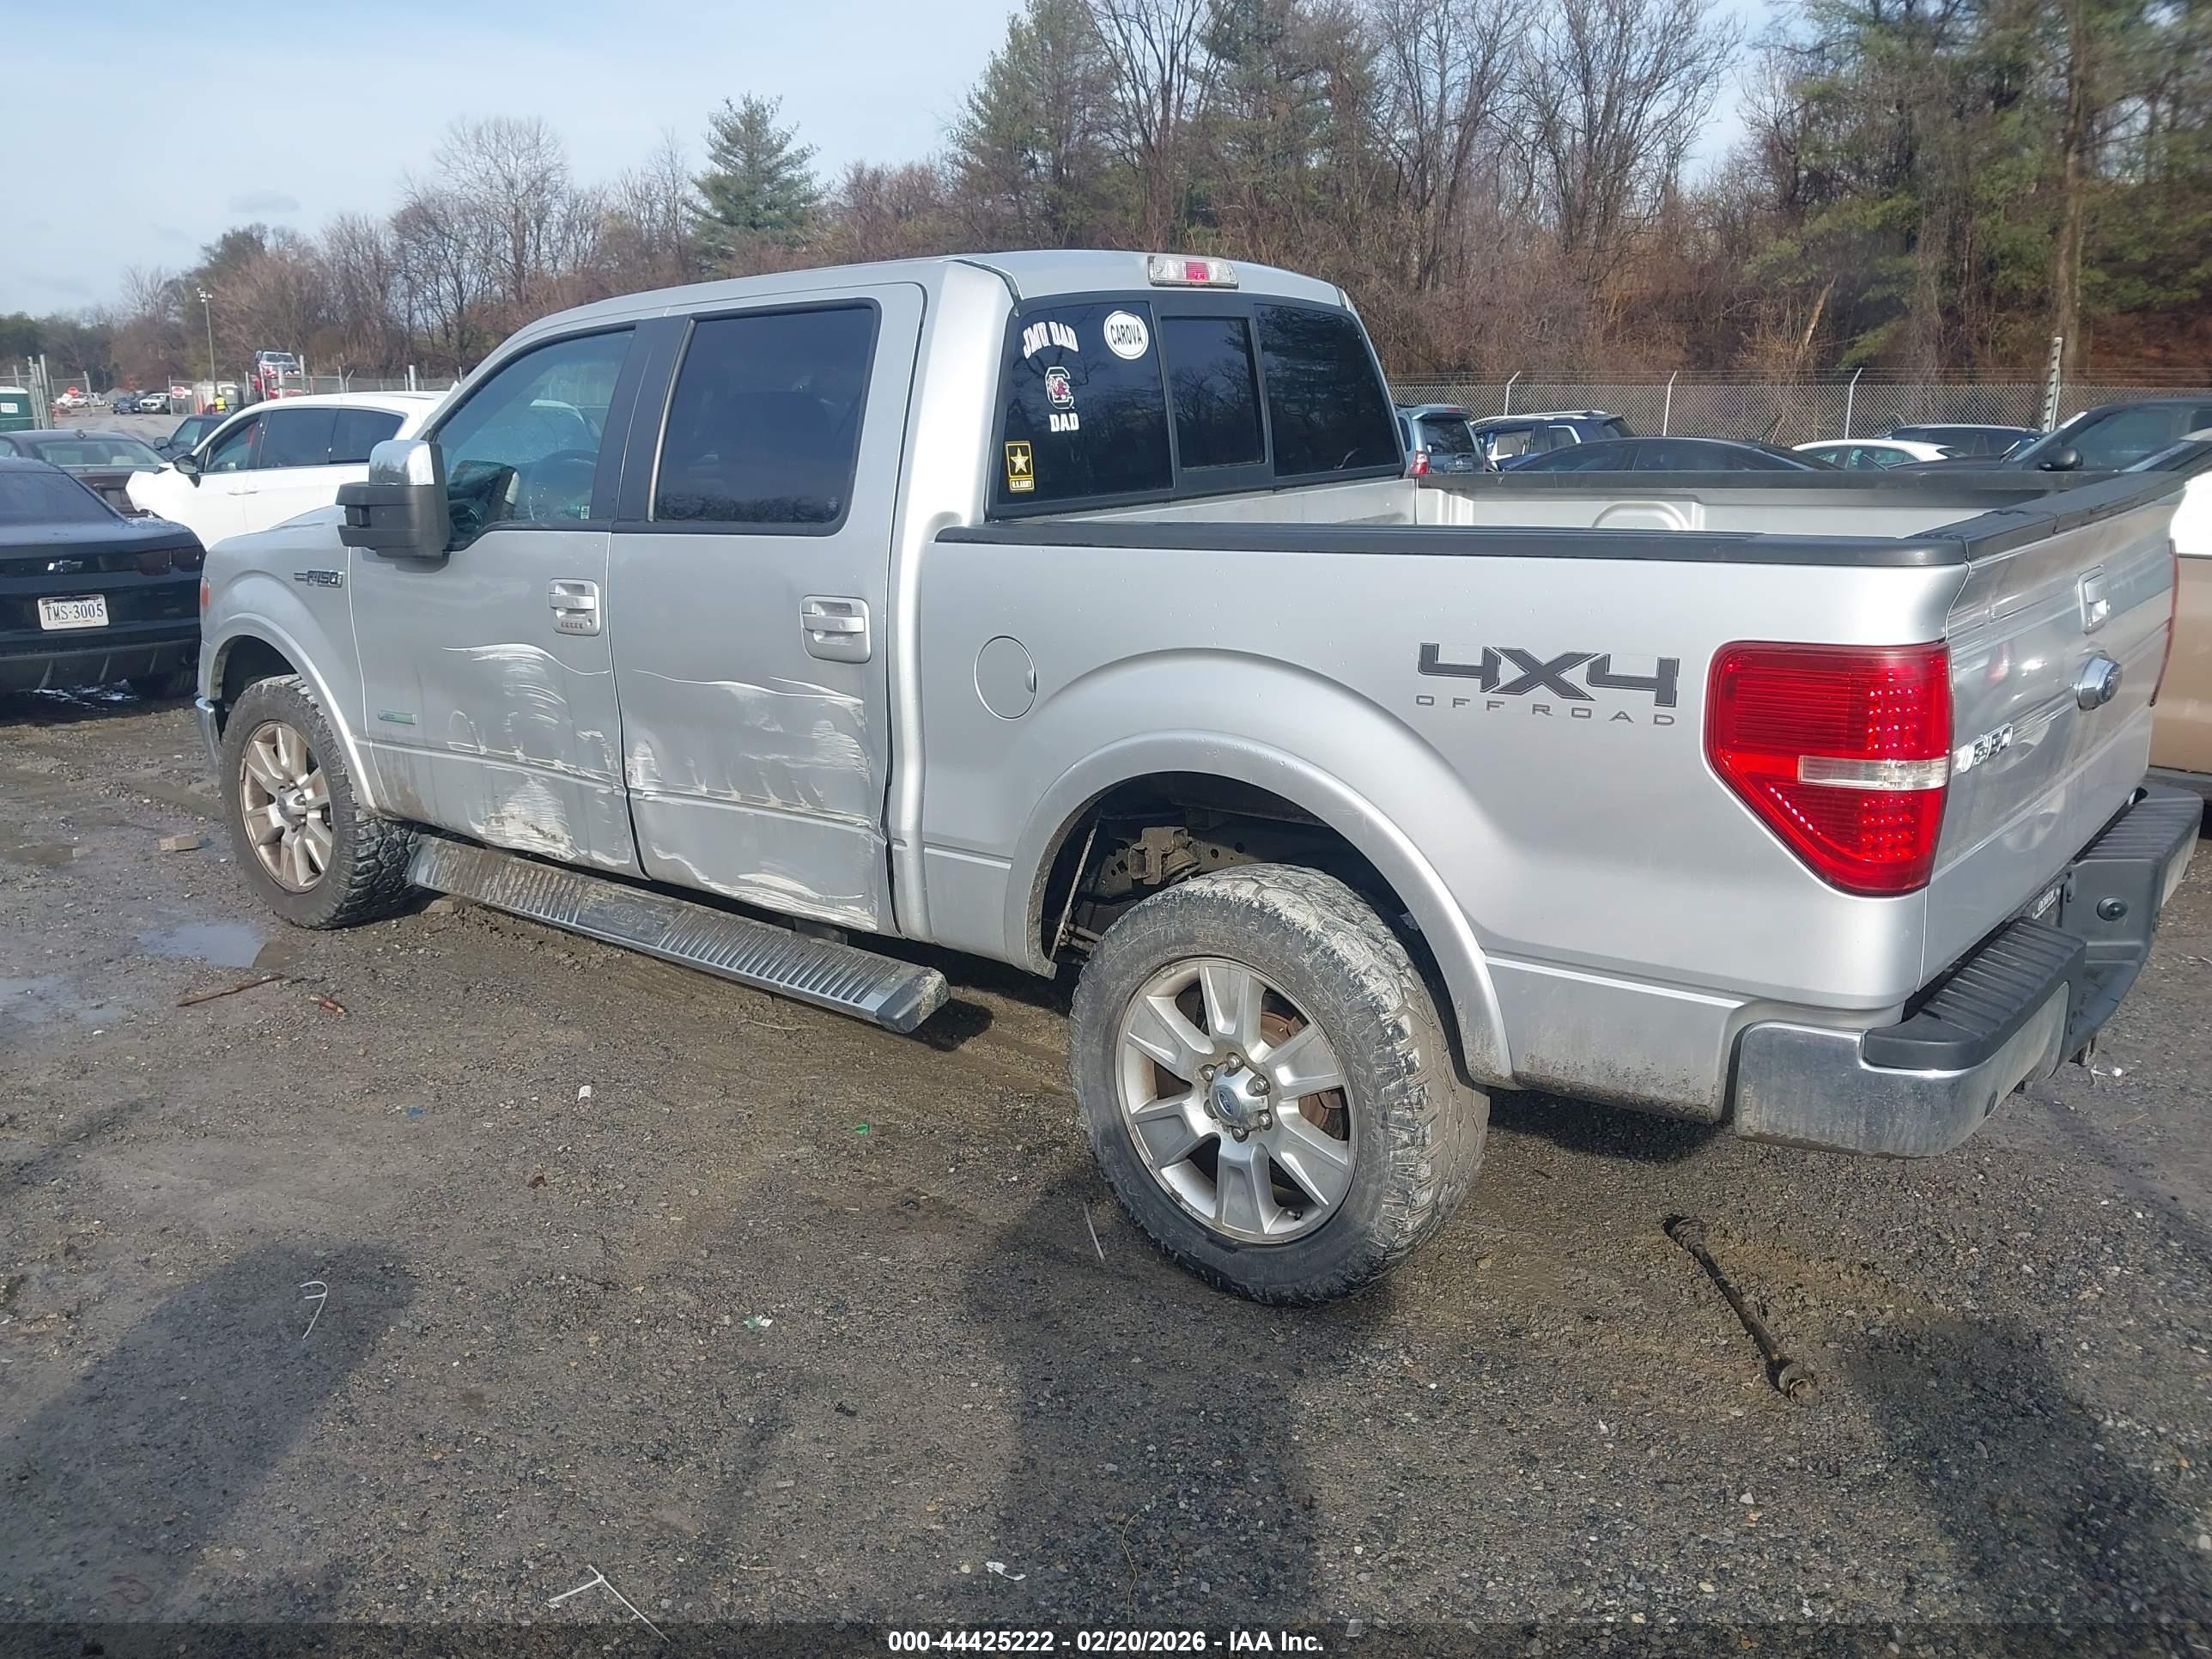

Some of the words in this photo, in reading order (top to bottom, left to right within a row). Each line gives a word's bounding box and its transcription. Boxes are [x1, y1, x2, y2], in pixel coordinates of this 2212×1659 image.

[1048, 321, 1079, 352] DAD
[1110, 324, 1144, 345] CAROVA
[1048, 413, 1079, 433] DAD
